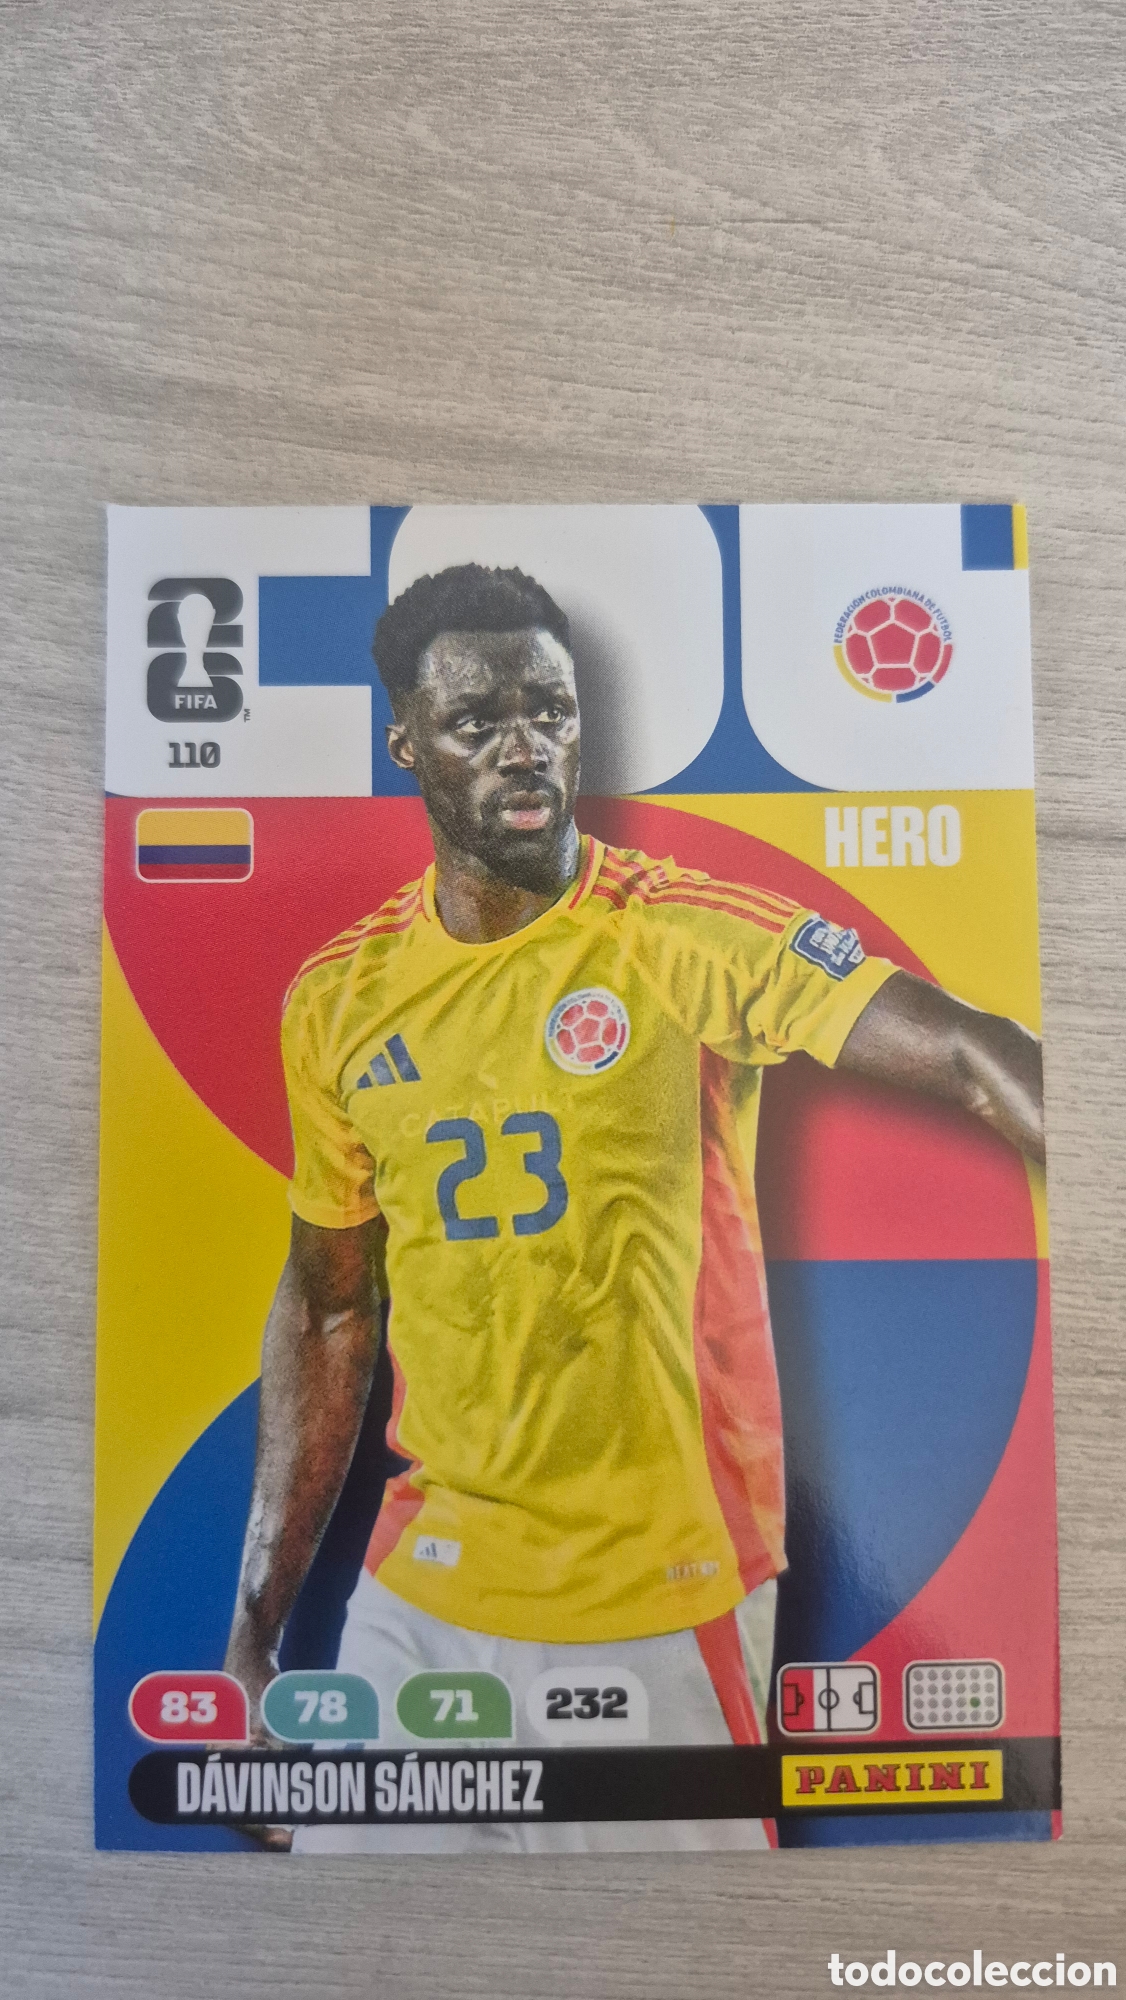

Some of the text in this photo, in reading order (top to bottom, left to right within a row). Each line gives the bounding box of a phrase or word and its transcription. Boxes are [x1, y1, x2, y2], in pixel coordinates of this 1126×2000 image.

[865, 586, 925, 603] COLOMBIANA
[924, 598, 936, 611] DE
[174, 694, 218, 710] FIFA
[168, 741, 221, 769] 110
[824, 804, 961, 868] HERO
[425, 1110, 569, 1241] 23
[160, 1690, 218, 1724] 83
[294, 1689, 348, 1724] 78
[430, 1688, 479, 1722] 71
[546, 1686, 629, 1720] 232
[177, 1752, 543, 1814] DÁVINSON SÁNCHEZ
[795, 1761, 991, 1795] PANINI
